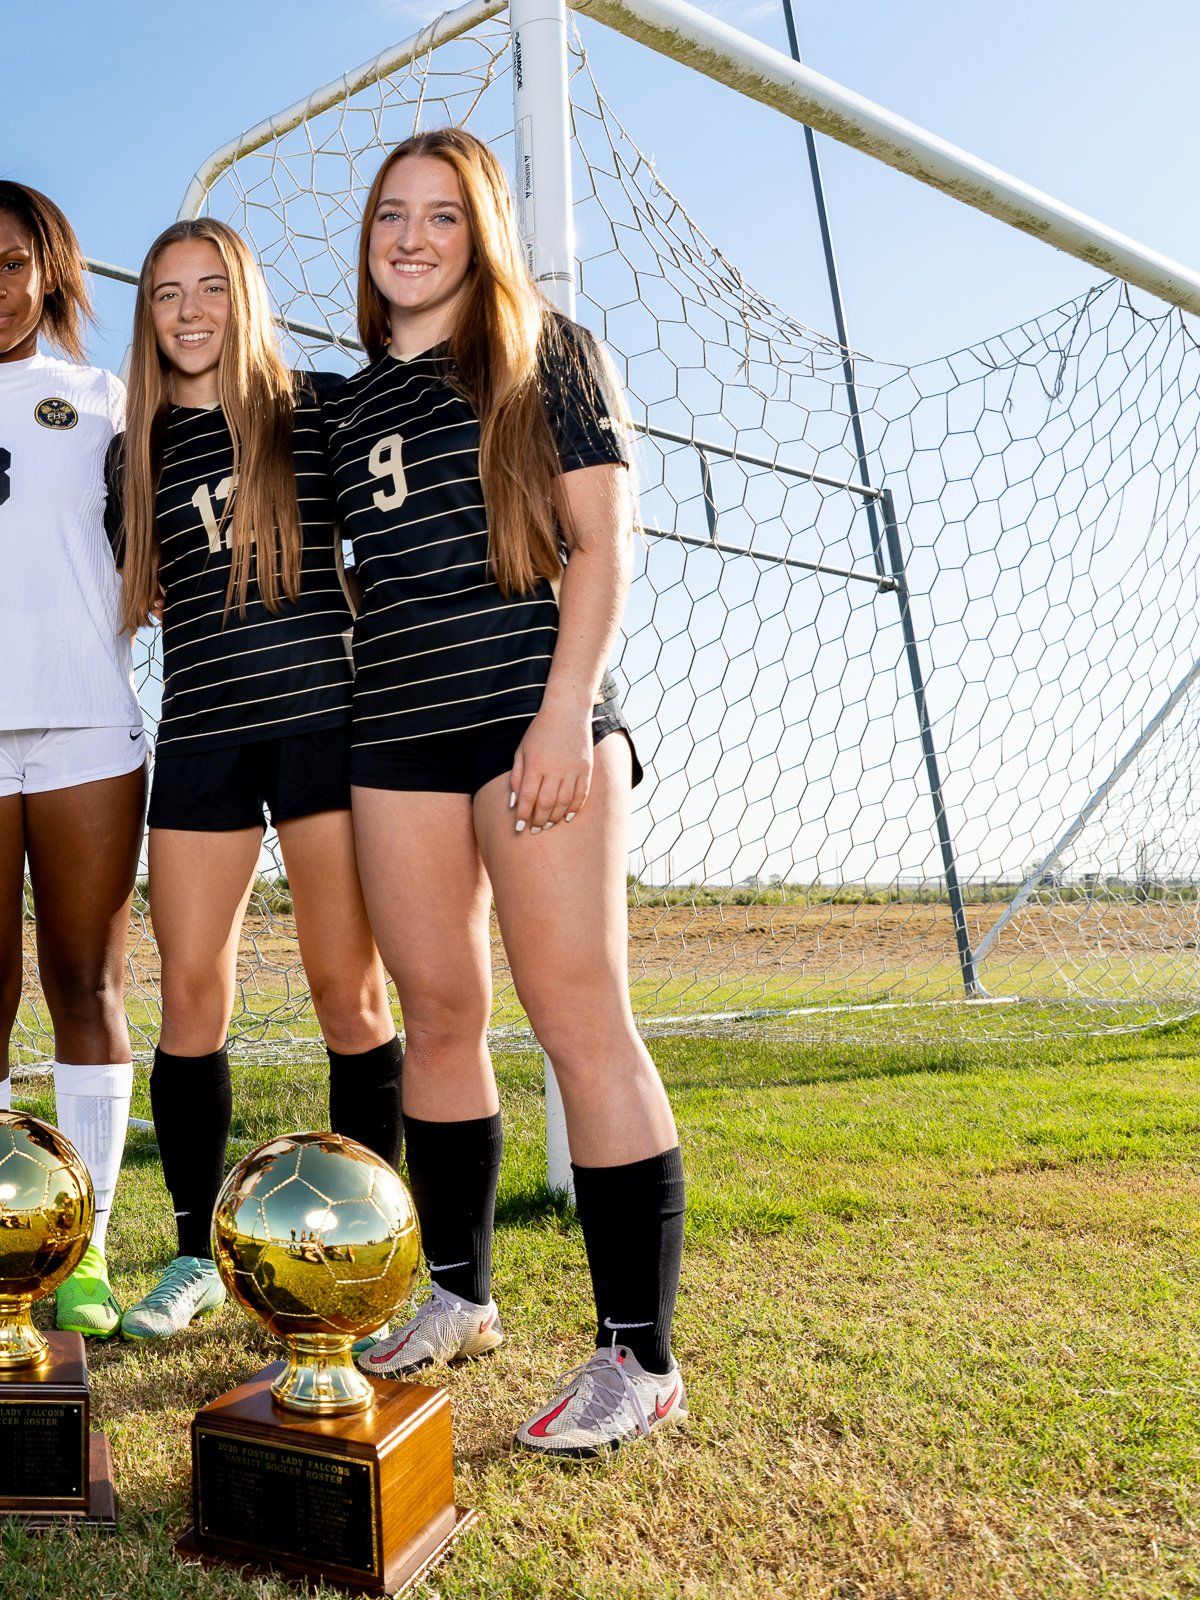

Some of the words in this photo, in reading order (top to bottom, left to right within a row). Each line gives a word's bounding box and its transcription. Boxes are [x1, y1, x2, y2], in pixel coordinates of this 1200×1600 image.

[368, 433, 408, 513] 9
[0, 1409, 21, 1417] LADY
[26, 1409, 65, 1417] FALCONS
[24, 1418, 58, 1426] ROSTER
[217, 1443, 238, 1454] 2020
[242, 1447, 277, 1462] FOSTER
[281, 1455, 304, 1467] LADY
[308, 1461, 351, 1477] FALCONS
[224, 1453, 261, 1469] VARSITY
[265, 1462, 302, 1477] SOCCER
[306, 1470, 344, 1485] ROSTER
